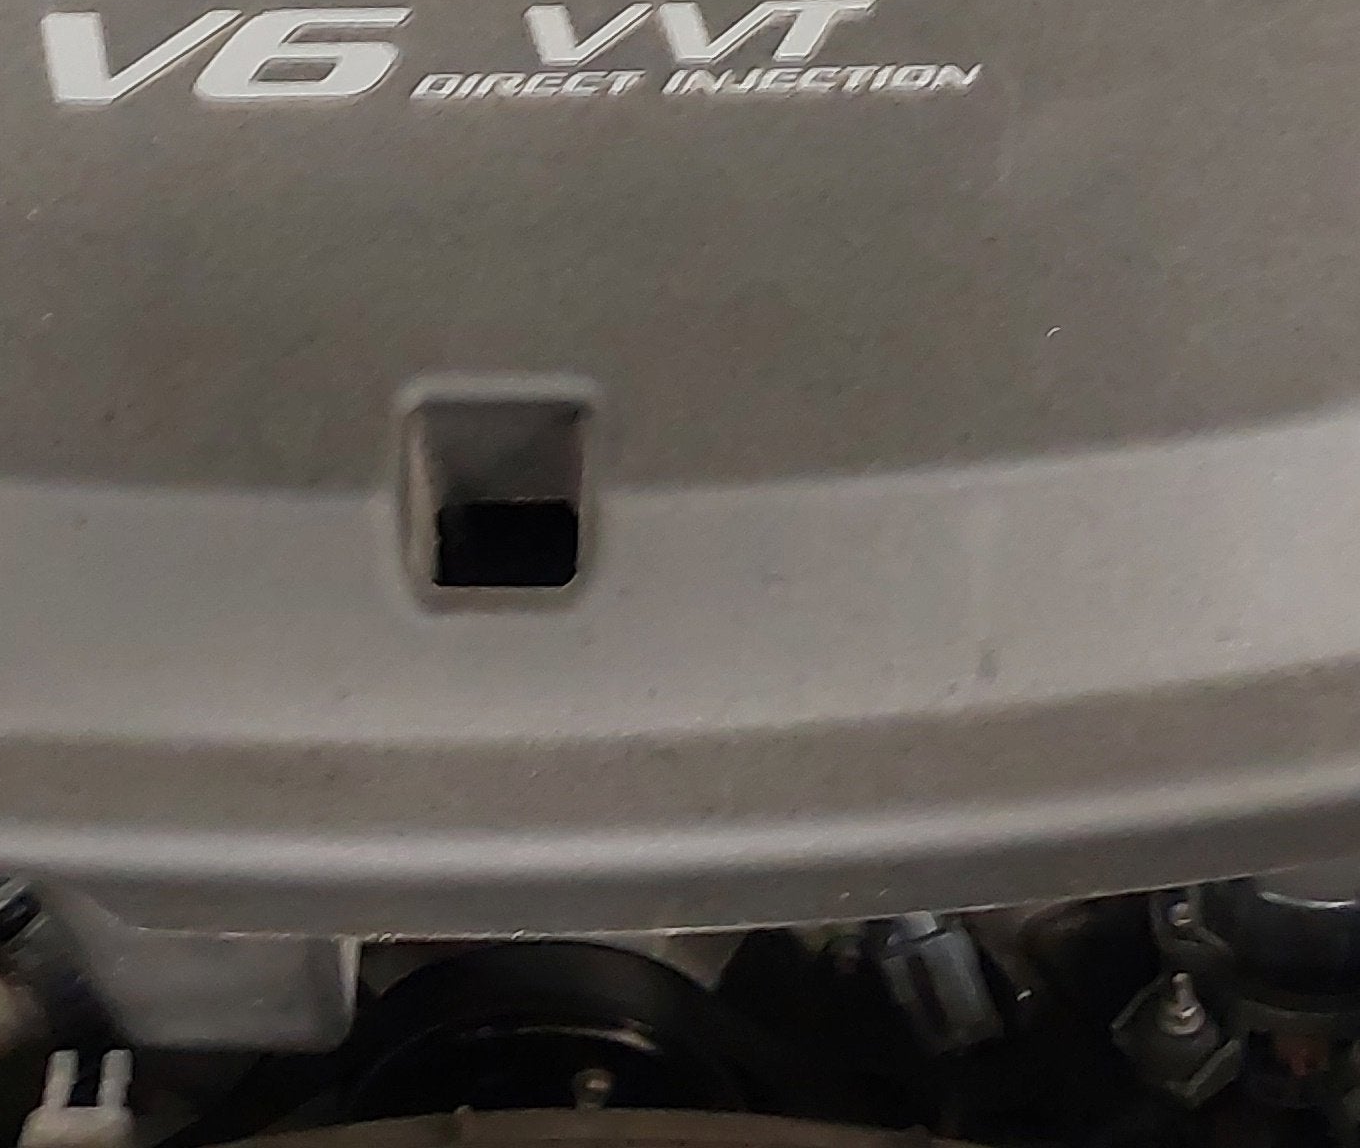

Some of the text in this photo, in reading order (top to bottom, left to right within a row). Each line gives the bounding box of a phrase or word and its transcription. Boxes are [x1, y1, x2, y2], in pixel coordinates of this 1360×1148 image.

[42, 7, 413, 104] V6
[410, 64, 983, 99] DIRECT INJECTION
